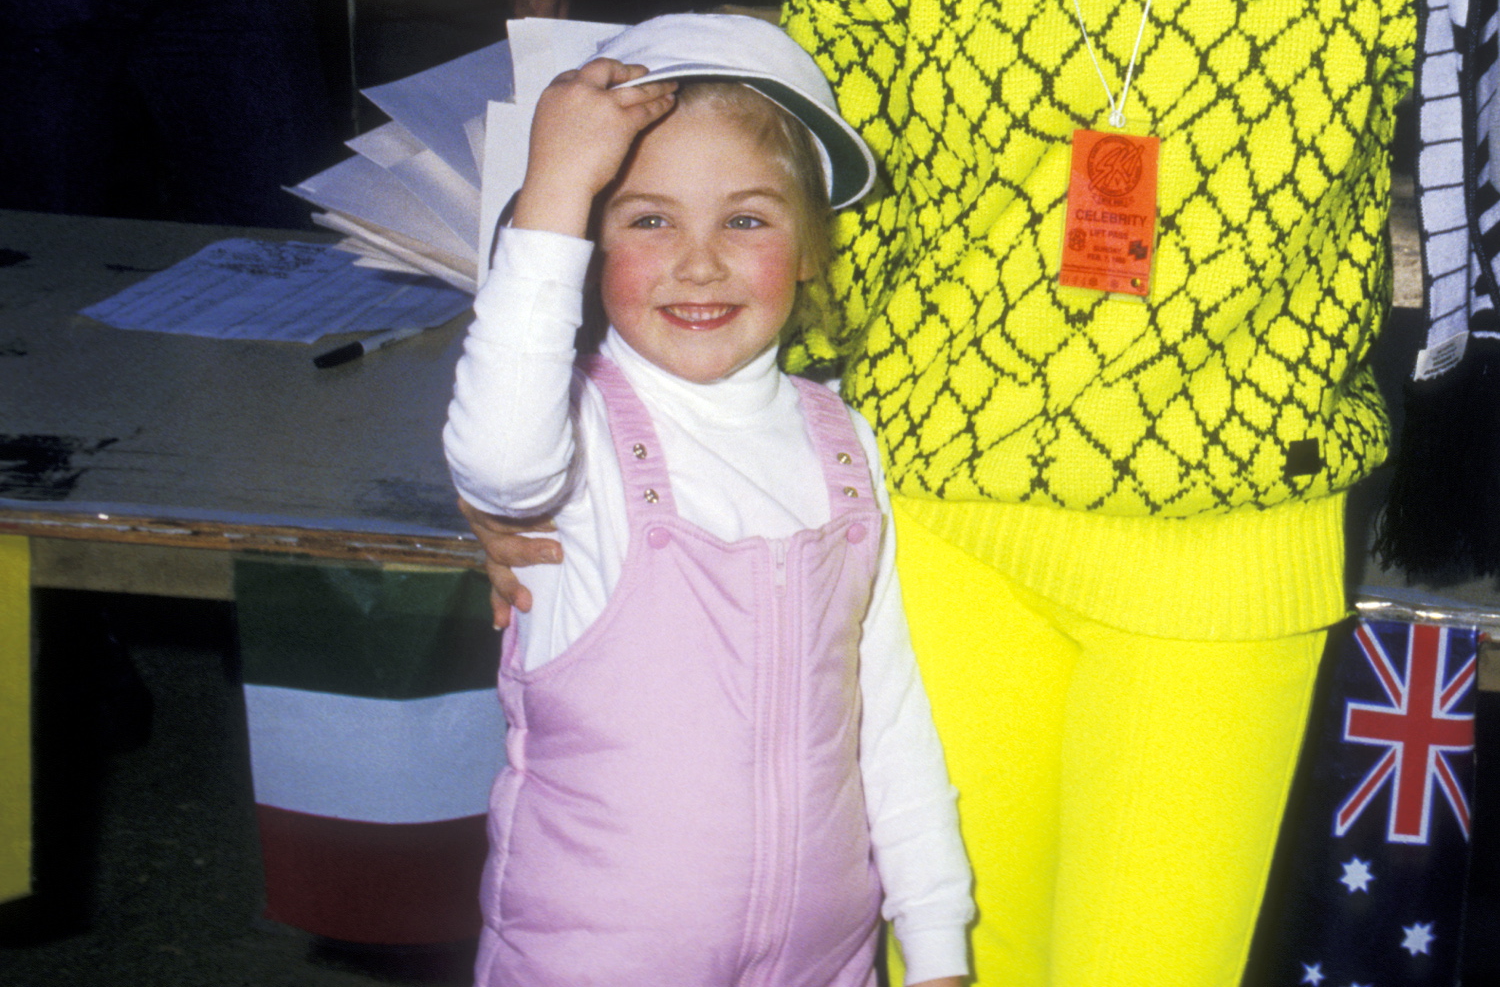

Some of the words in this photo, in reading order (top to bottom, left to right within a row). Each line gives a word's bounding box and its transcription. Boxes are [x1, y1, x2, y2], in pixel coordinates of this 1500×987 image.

[1075, 208, 1148, 227] CELEBRITY
[1089, 229, 1107, 237] LIFT
[1107, 230, 1129, 240] PASS
